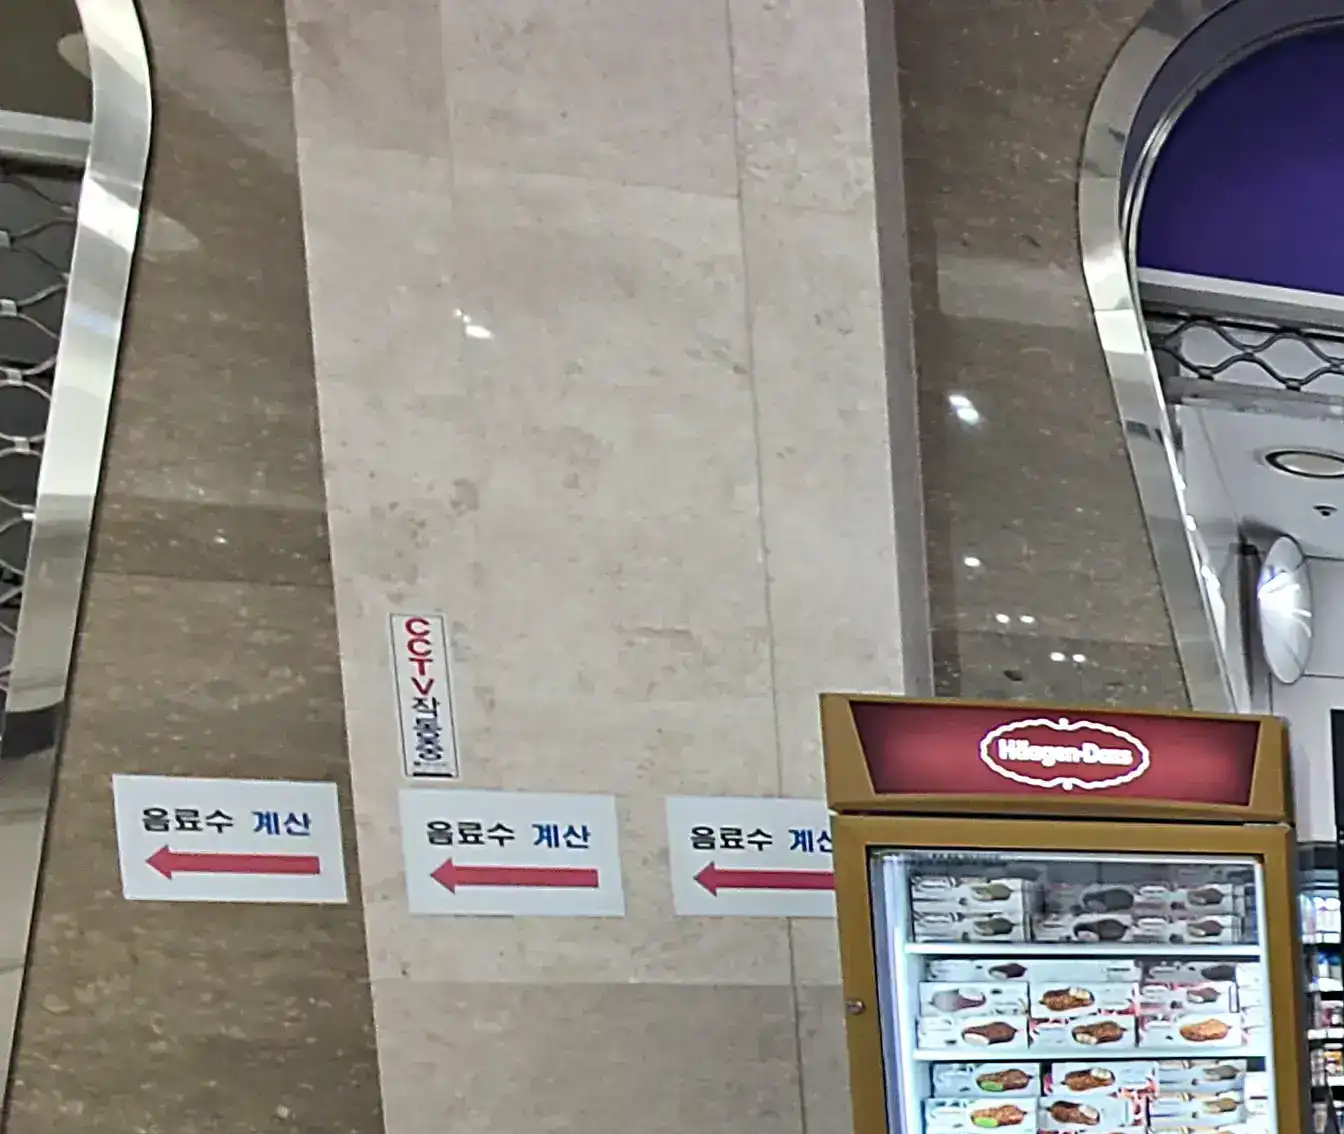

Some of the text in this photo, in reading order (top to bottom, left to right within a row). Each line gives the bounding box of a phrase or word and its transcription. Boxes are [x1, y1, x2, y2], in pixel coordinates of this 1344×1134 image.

[141, 805, 312, 839] 음료수 계산
[426, 819, 591, 851] 음료수 계산
[689, 824, 774, 854] 음료수
